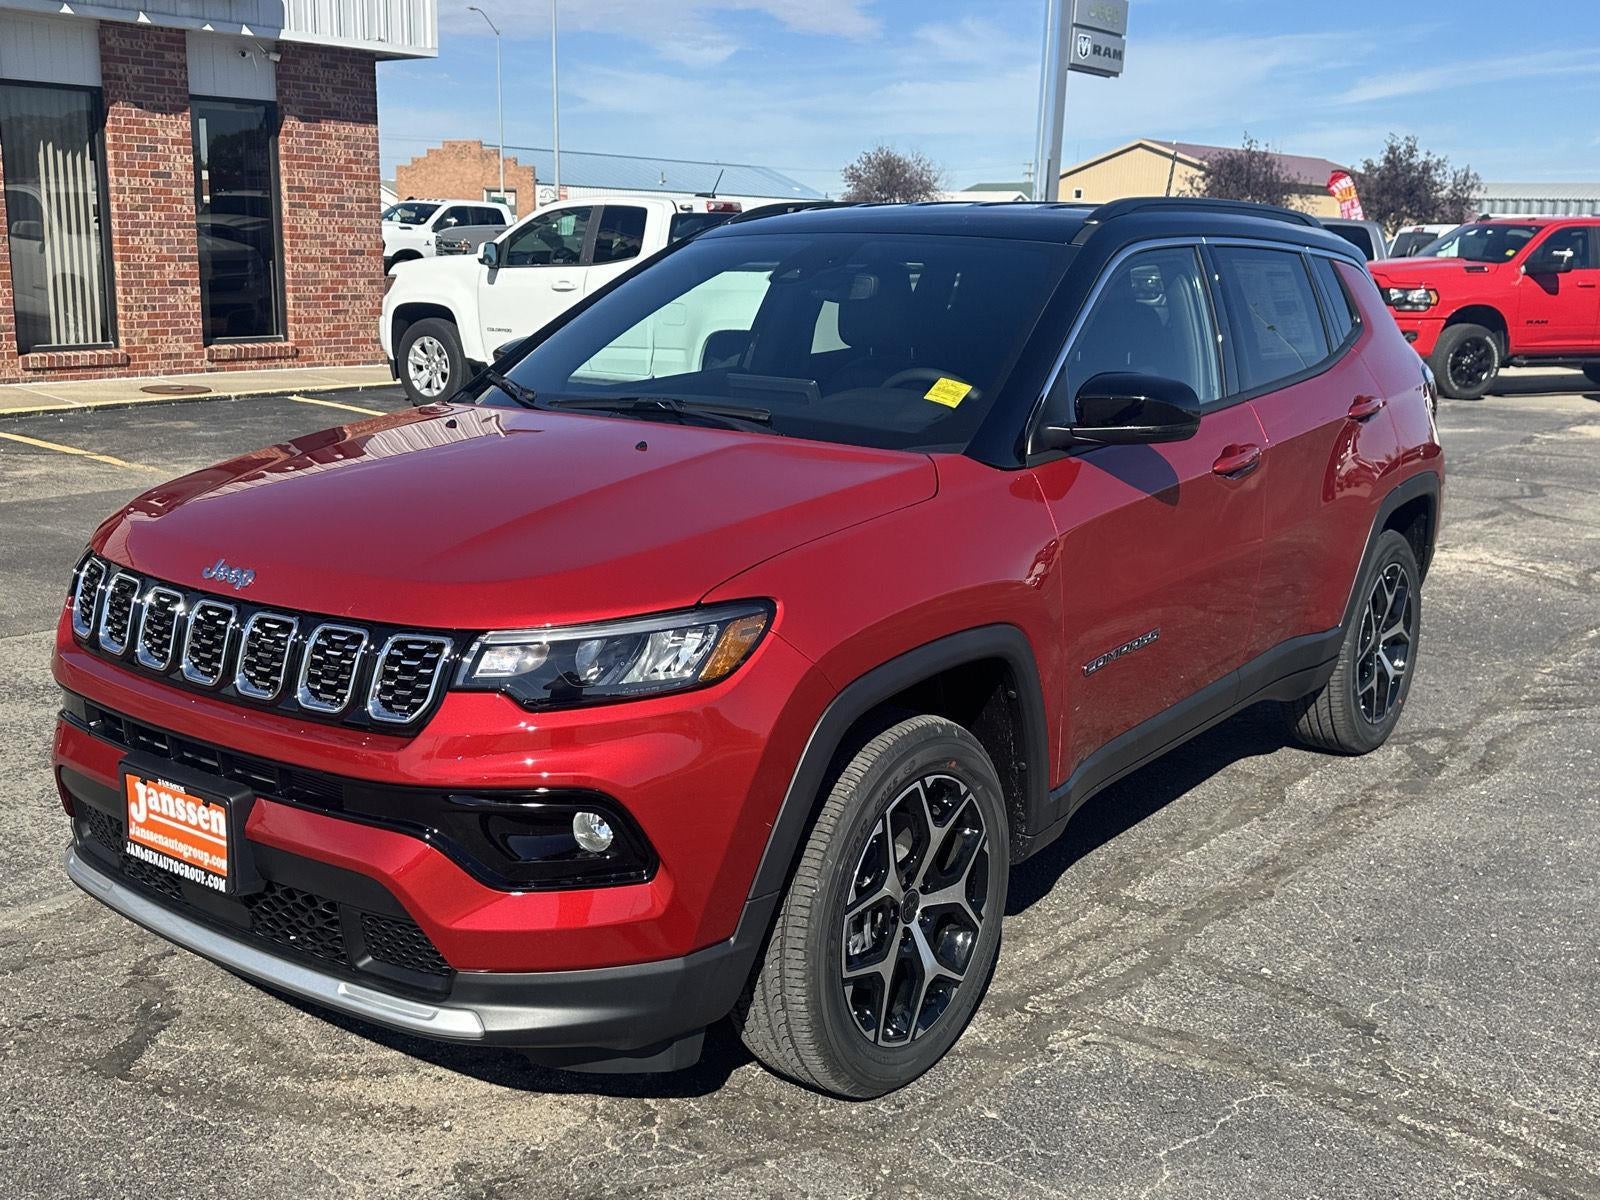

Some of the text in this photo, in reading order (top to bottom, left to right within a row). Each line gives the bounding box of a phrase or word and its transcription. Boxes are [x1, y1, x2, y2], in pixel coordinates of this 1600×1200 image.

[1093, 44, 1122, 60] RAM
[202, 559, 256, 590] Jeep
[1082, 627, 1160, 678] COMPASS
[130, 781, 227, 836] Janssen
[126, 841, 227, 893] JANSSENAUTOGROUP.COM
[129, 822, 228, 870] Janssenautogroup.com
